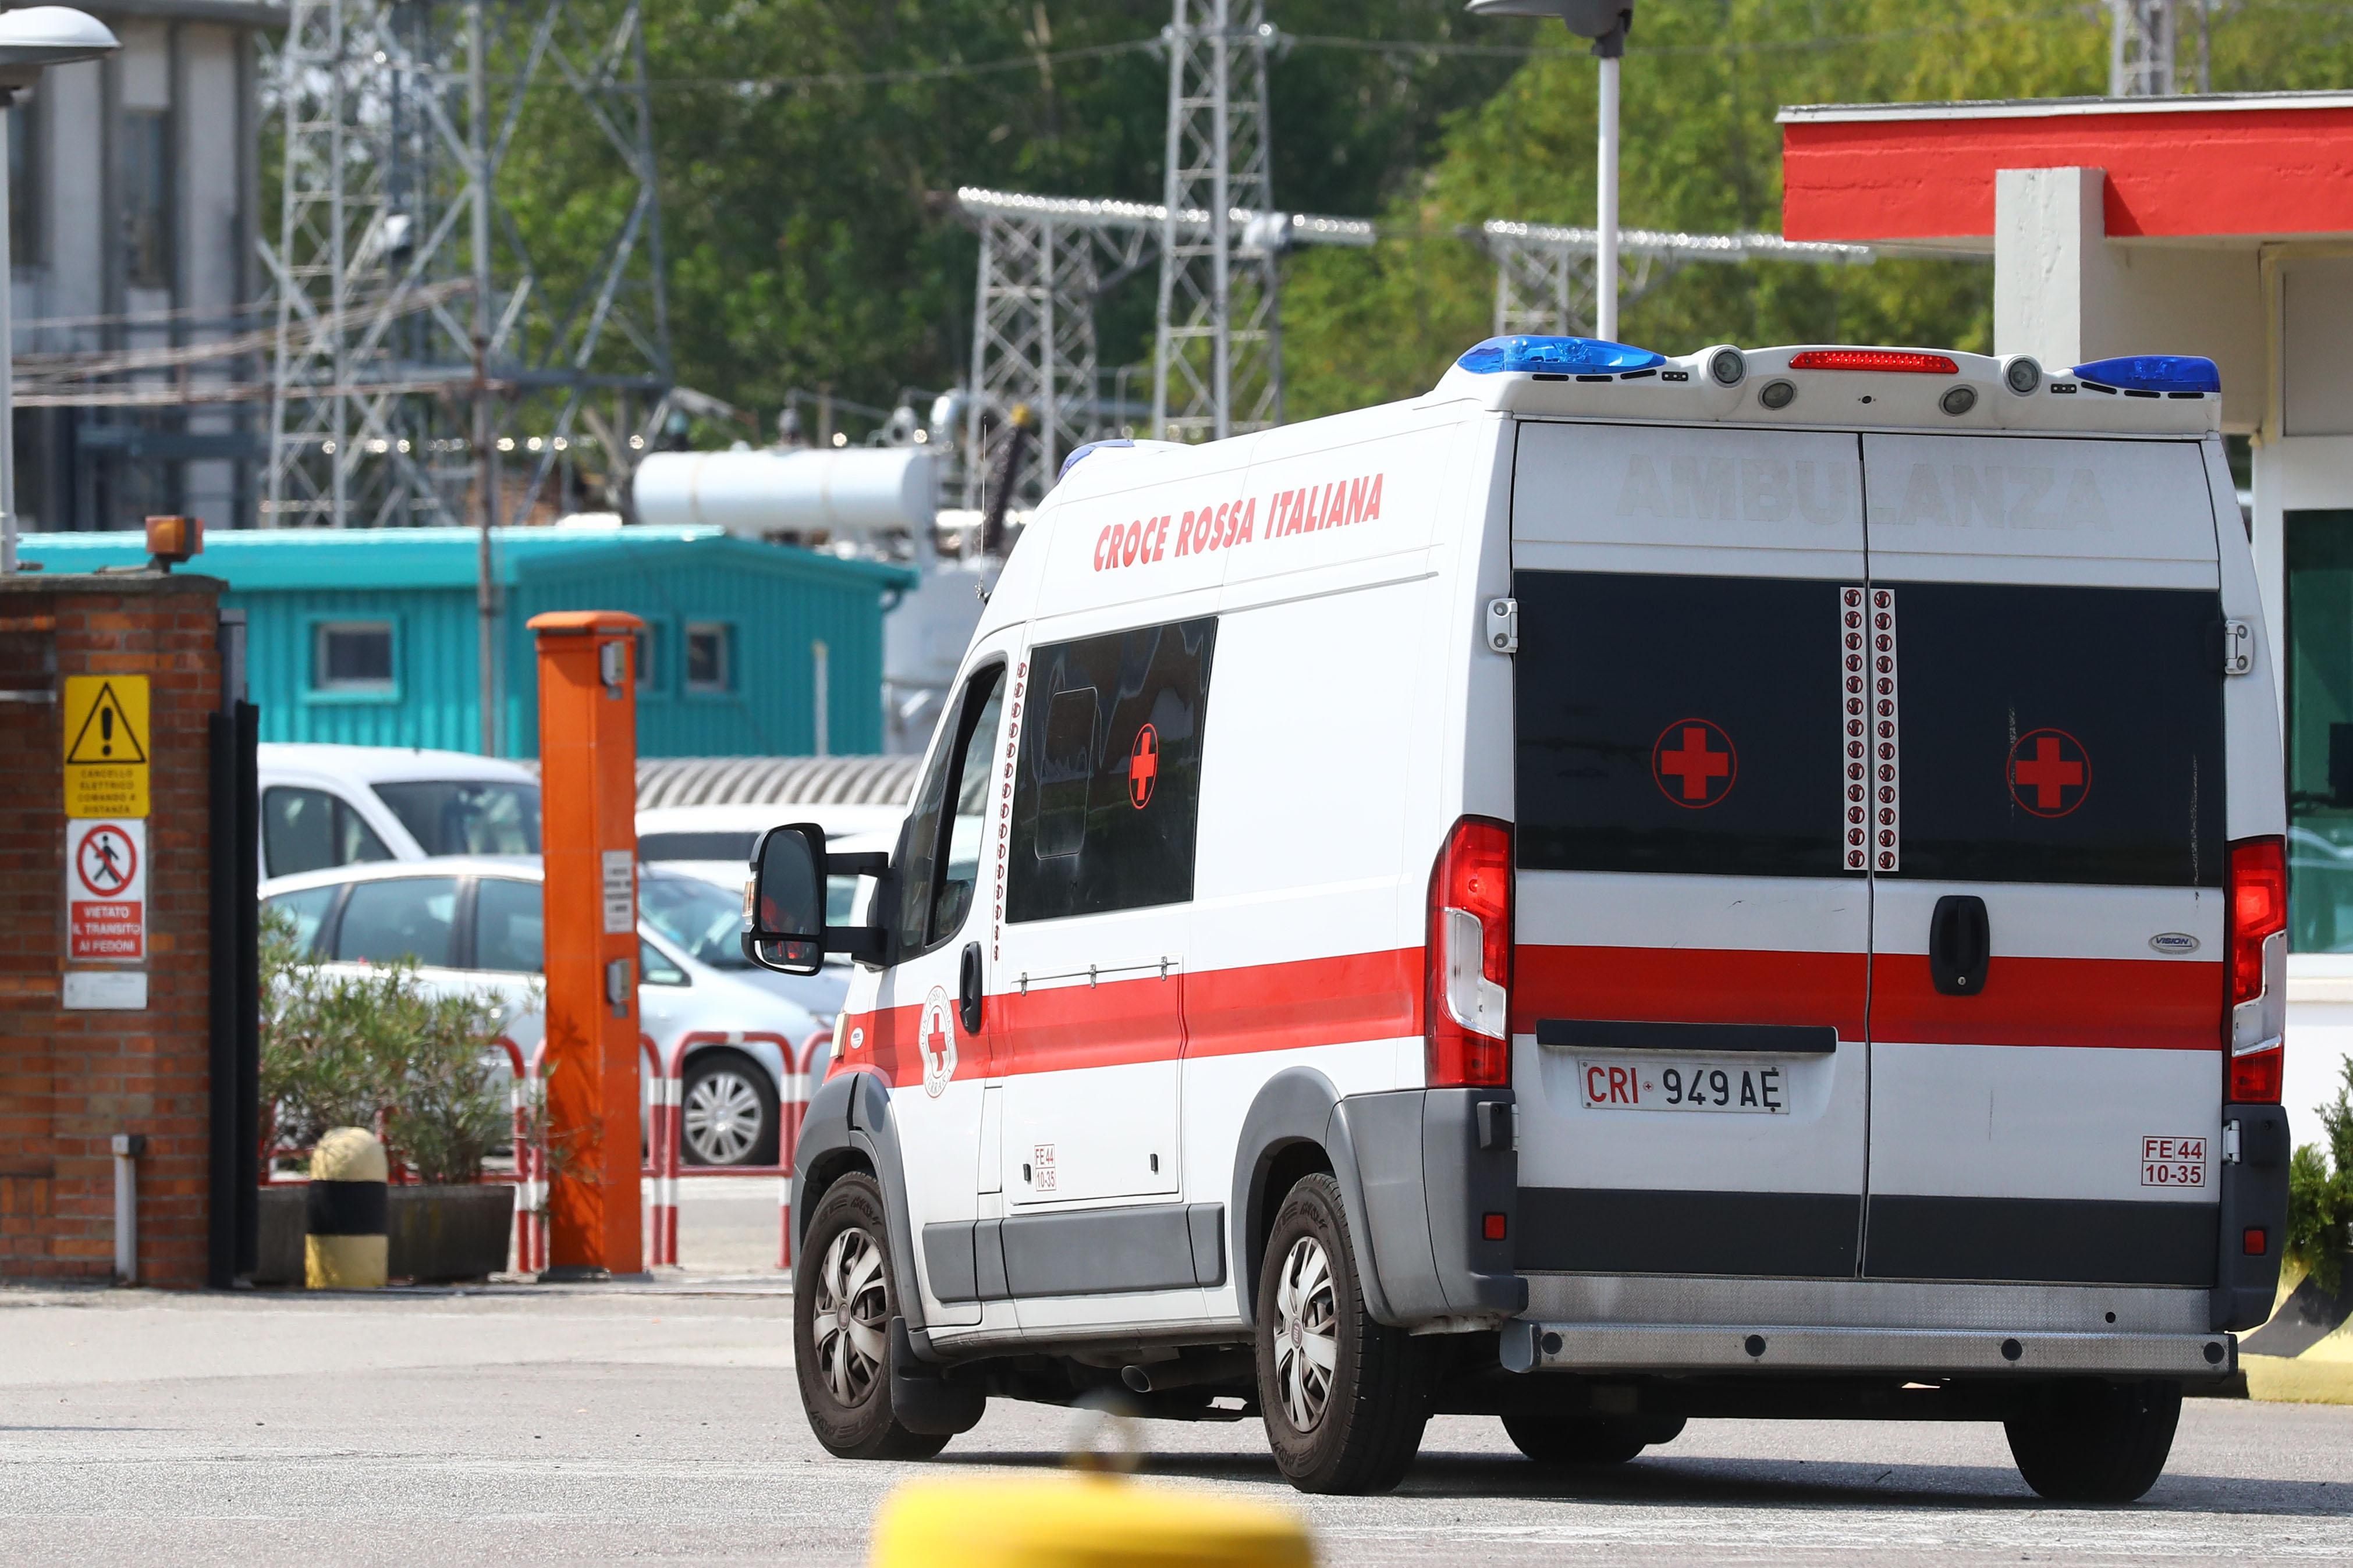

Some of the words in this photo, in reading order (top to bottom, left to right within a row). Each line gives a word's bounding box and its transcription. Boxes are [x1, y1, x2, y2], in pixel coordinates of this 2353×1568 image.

[1616, 454, 2113, 531] AMBULANZA
[1094, 515, 1171, 572] CROCE
[1174, 498, 1256, 557] ROSSA
[1264, 473, 1383, 539] ITALIANA
[80, 768, 133, 778] CANCELLO
[80, 780, 134, 790] ELETTRICO
[77, 792, 126, 802] COMANDO
[130, 793, 136, 801] A
[84, 805, 130, 814] DISTANZA
[84, 906, 129, 919] VIETATO
[73, 922, 82, 935] IL
[85, 922, 140, 936] TRANSITO
[79, 940, 90, 952] AI
[92, 940, 135, 952] PEDONI
[1587, 1066, 1638, 1104] CRI
[1663, 1069, 1729, 1106] 949
[1740, 1071, 1781, 1108] AE
[1036, 1148, 1044, 1165] FE
[1046, 1148, 1053, 1164] 44
[2145, 1140, 2173, 1158] FE
[2178, 1142, 2202, 1159] 44
[1037, 1171, 1055, 1187] 10-35
[2146, 1164, 2201, 1183] 10-35
